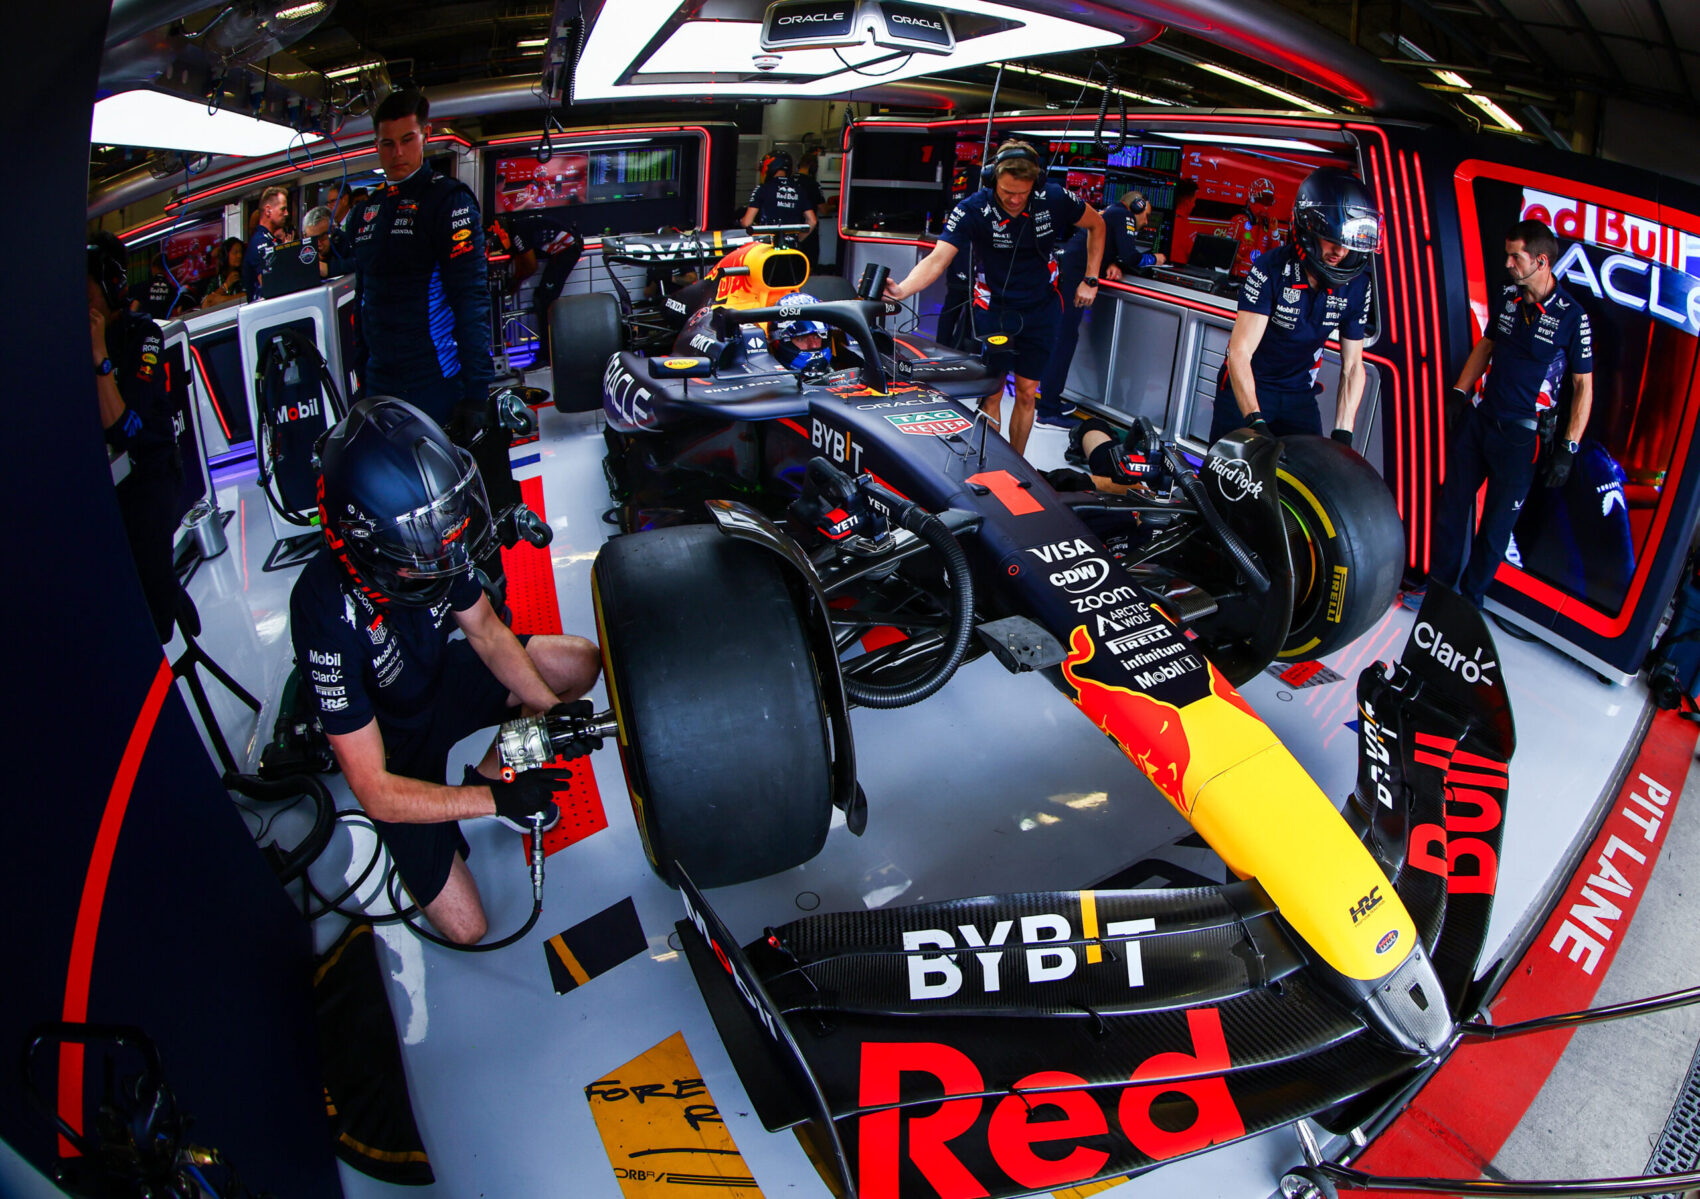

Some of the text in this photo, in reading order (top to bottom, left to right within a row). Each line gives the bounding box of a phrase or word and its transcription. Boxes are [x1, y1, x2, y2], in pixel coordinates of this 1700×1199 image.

[778, 12, 845, 26] ORACLE
[891, 14, 943, 31] ORACLE
[1521, 193, 1681, 271] ed Bull
[1251, 265, 1268, 283] Mobil
[277, 397, 319, 425] Mobil
[856, 398, 949, 411] ORACLE
[892, 410, 954, 423] TAG
[171, 409, 186, 437] bil
[899, 420, 970, 434] HEUER
[812, 417, 864, 475] BYBIT
[1128, 462, 1151, 473] YETI
[1164, 455, 1175, 473] YETI
[1208, 456, 1240, 481] Hard
[867, 495, 890, 517] YETI
[833, 515, 859, 534] YETI
[1026, 538, 1096, 564] VISA
[1049, 563, 1098, 588] CDW
[1070, 585, 1138, 613] zoom
[1327, 565, 1348, 623] PIRELLI
[1109, 602, 1149, 620] ARCTIC
[1121, 613, 1152, 628] WOLF
[1105, 623, 1173, 655] PIRELLI
[309, 649, 341, 667] Mobil
[372, 645, 393, 669] Mobil
[377, 649, 400, 678] ORACLE
[1120, 642, 1187, 671] infinitum
[1413, 620, 1497, 688] Claro
[312, 668, 343, 683] Claro
[1133, 660, 1186, 690] Mobil
[1548, 772, 1672, 976] PIT LANE
[1348, 885, 1384, 924] HRC
[902, 890, 1157, 1000] BYBIT
[858, 1007, 1247, 1199] Red
